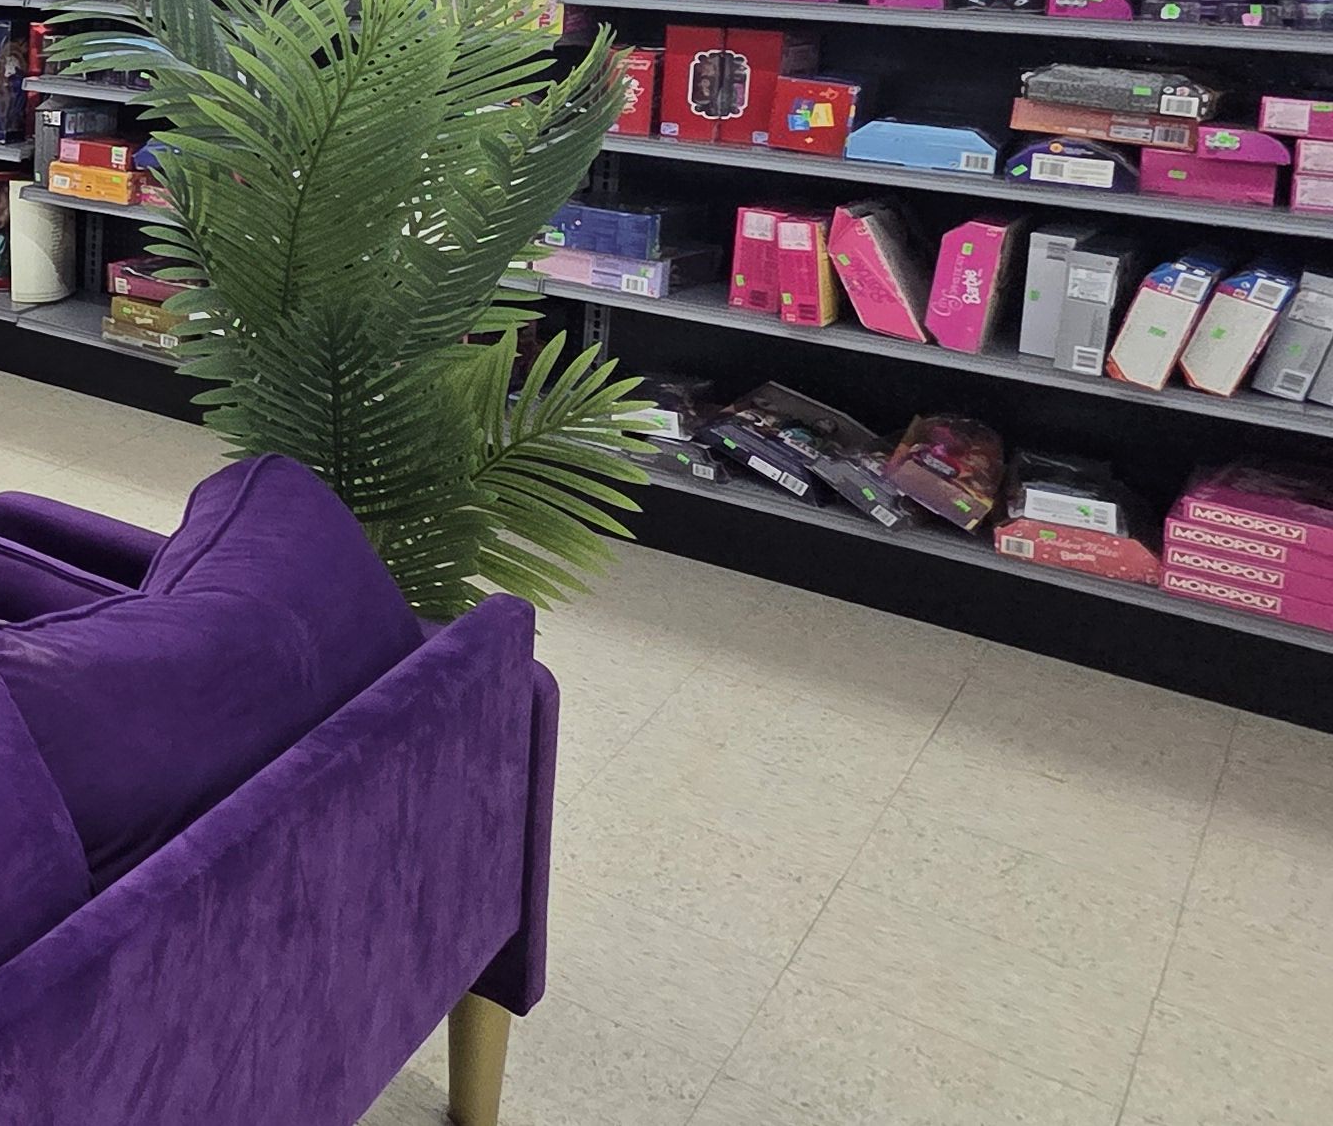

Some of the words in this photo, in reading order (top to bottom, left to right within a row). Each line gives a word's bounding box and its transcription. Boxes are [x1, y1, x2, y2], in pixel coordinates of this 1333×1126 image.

[962, 269, 982, 305] Barbie
[1194, 507, 1302, 539] MONOPOLY
[1174, 526, 1281, 558] MONOPOLY
[1172, 552, 1279, 584] MONOPOLY
[1169, 576, 1276, 609] MONOPOLY
